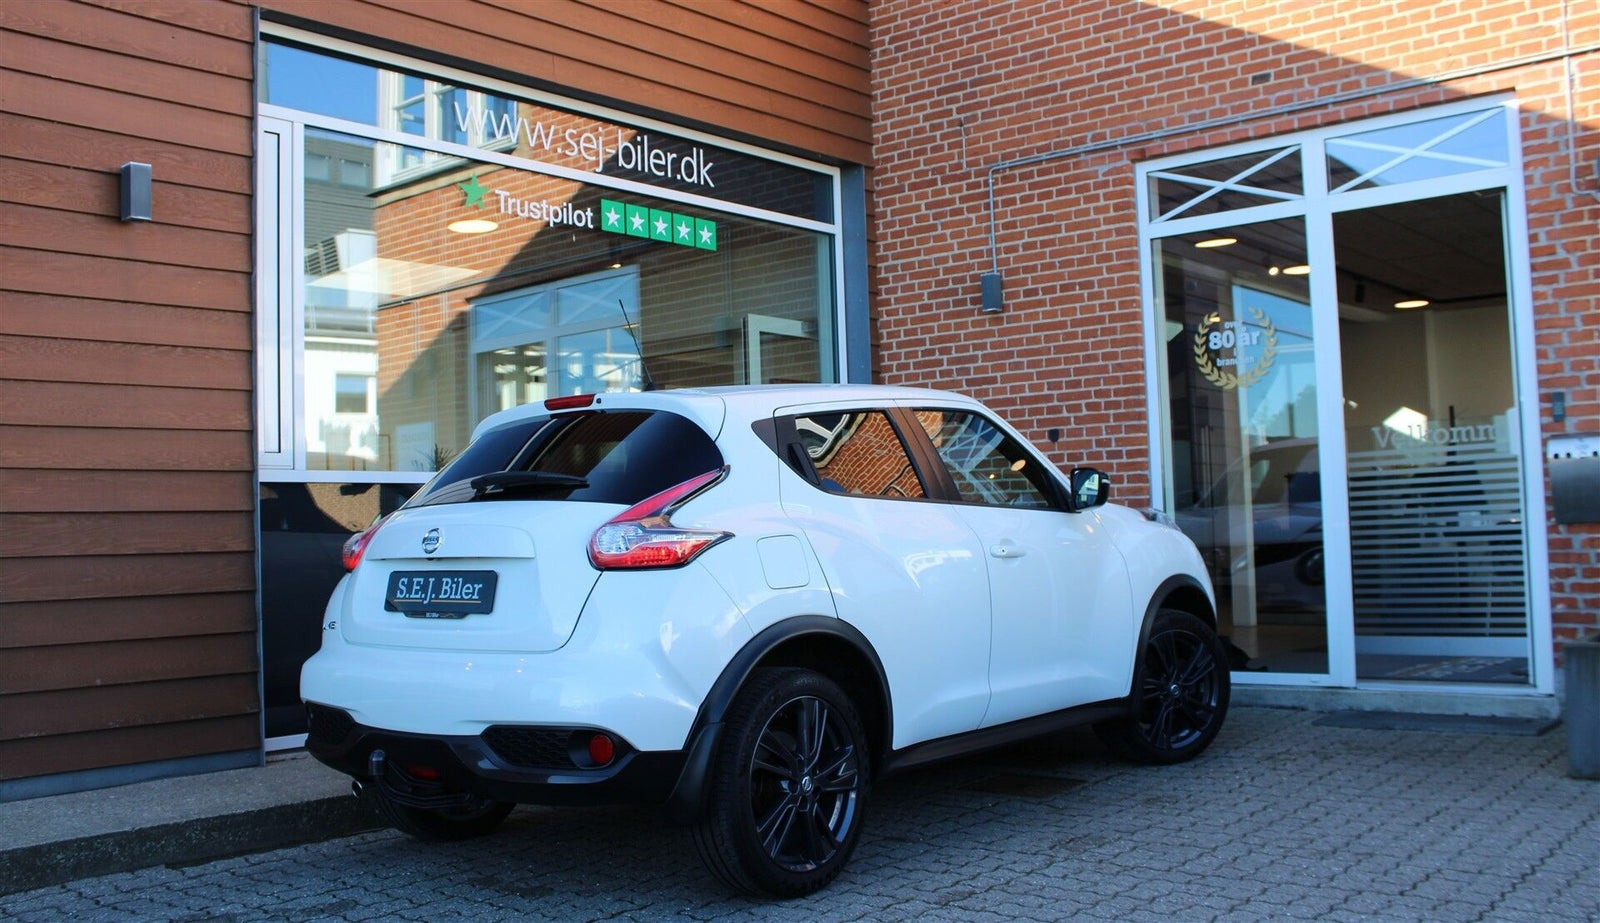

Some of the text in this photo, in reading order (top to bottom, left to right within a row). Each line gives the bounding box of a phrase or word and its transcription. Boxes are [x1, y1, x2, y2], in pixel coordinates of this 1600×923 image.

[454, 101, 715, 188] www.sej-biler.dk
[495, 189, 594, 229] Trustpilot
[1208, 326, 1260, 350] 80 år
[396, 577, 483, 604] S.E.J. Biler
